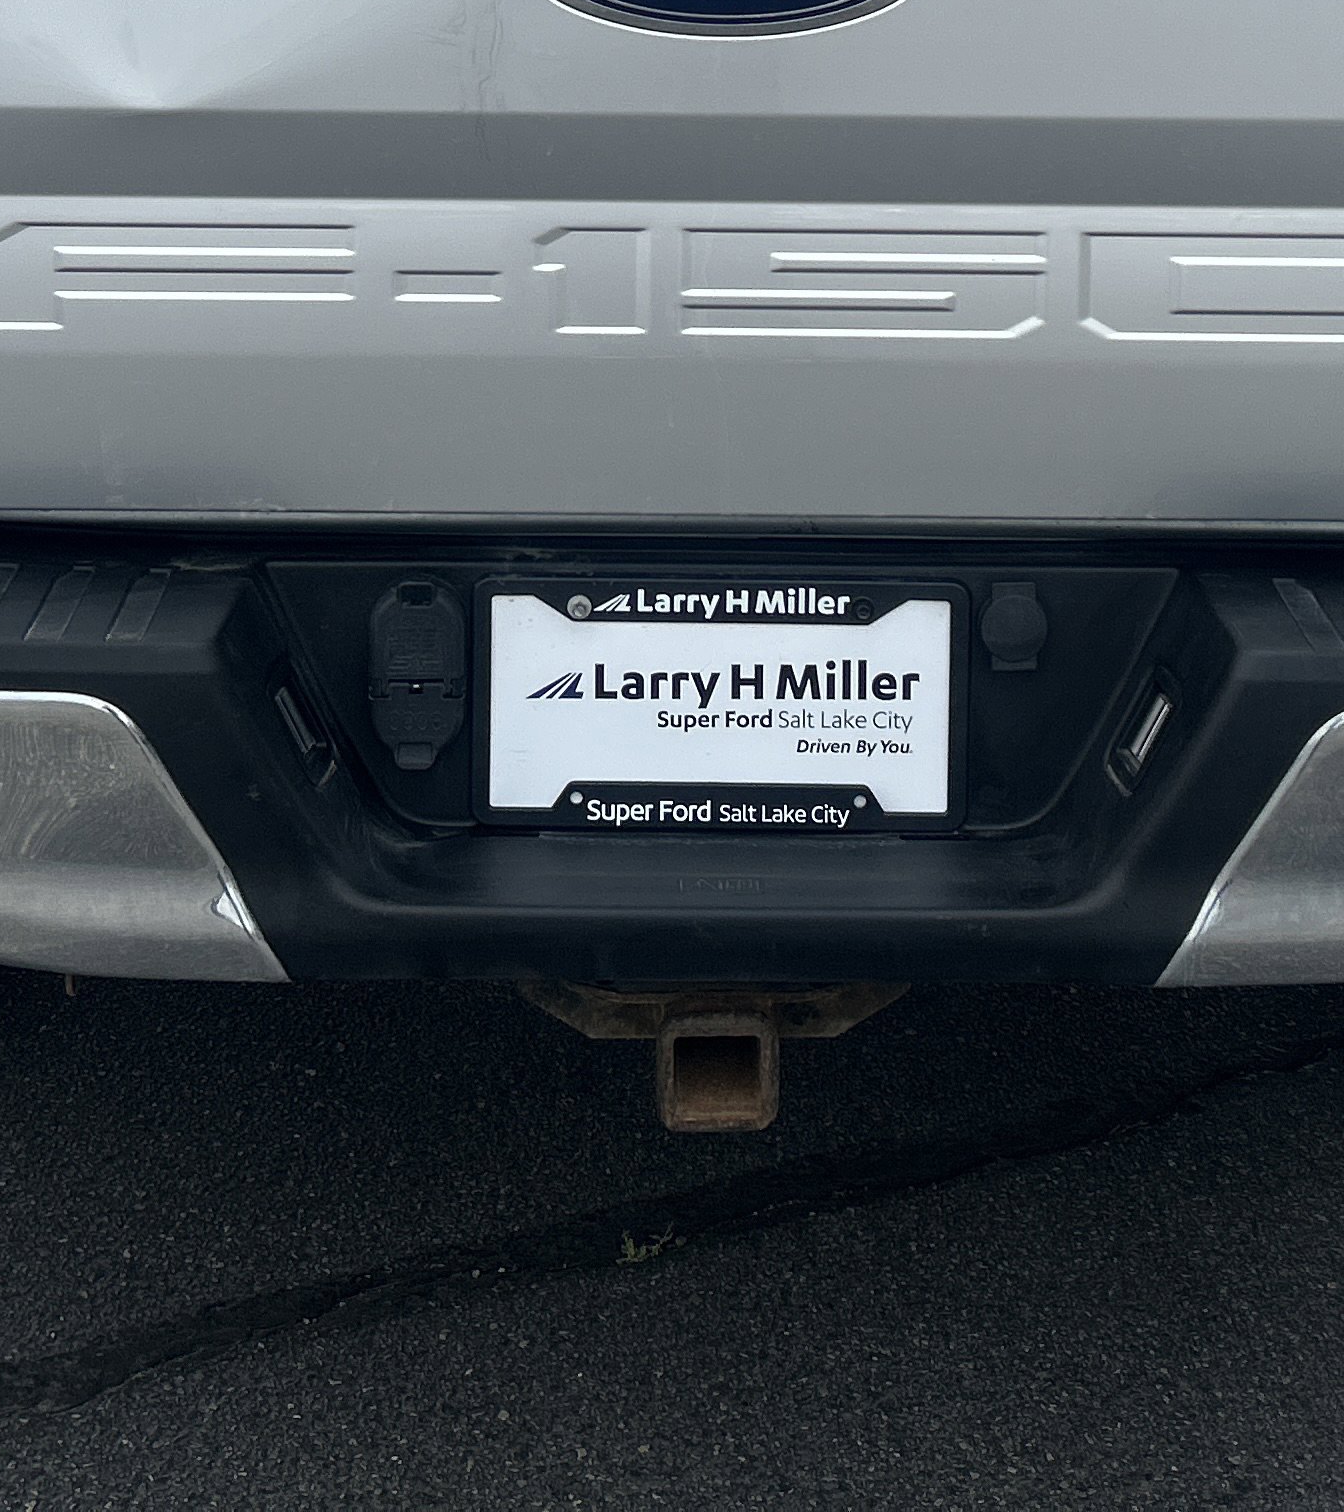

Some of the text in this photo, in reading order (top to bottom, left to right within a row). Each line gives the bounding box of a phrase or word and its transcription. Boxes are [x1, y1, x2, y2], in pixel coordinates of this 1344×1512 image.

[637, 587, 851, 620] Larry H Miller
[594, 659, 920, 709] Larry H Miller
[657, 708, 914, 735] Super Ford Salt Lake City
[796, 738, 851, 754] Driven
[855, 739, 878, 758] By
[586, 799, 850, 829] Super Ford Salt Lake City
